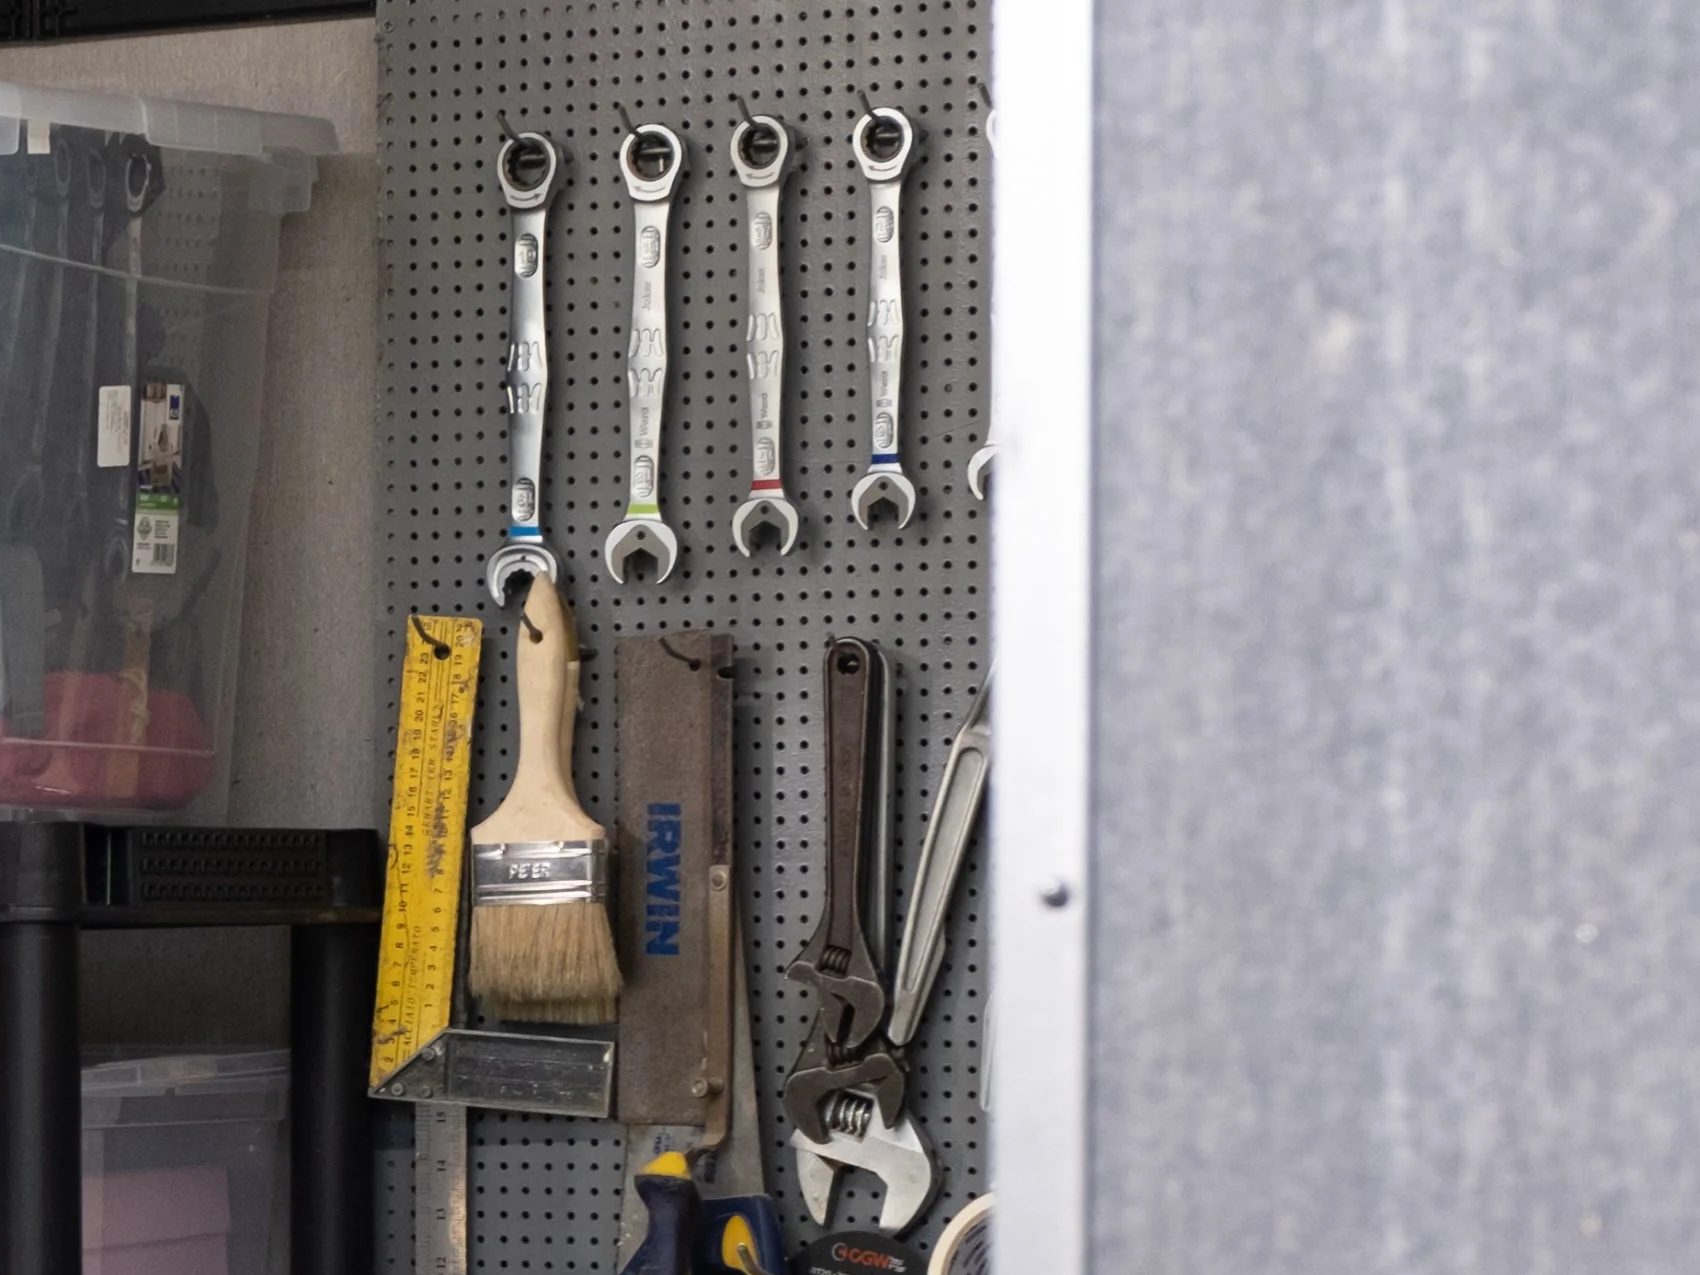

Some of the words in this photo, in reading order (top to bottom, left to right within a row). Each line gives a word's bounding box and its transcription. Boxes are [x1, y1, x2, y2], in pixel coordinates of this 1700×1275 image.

[420, 652, 429, 664] 23
[417, 672, 427, 684] 22
[416, 692, 425, 703] 21
[450, 694, 459, 704] 17
[414, 710, 424, 722] 20
[409, 768, 419, 779] 17
[443, 770, 453, 781] 13
[442, 789, 452, 800] 12
[406, 806, 416, 817] 15
[403, 844, 413, 855] 13
[401, 863, 411, 874] 12
[509, 862, 551, 879] PEER
[645, 802, 682, 957] IRWIN
[400, 883, 409, 893] 11
[398, 901, 408, 912] 10
[435, 1111, 447, 1124] 15
[436, 1160, 447, 1172] 14
[436, 1208, 446, 1221] 13
[436, 1256, 447, 1269] 12
[848, 1250, 890, 1269] CGW
